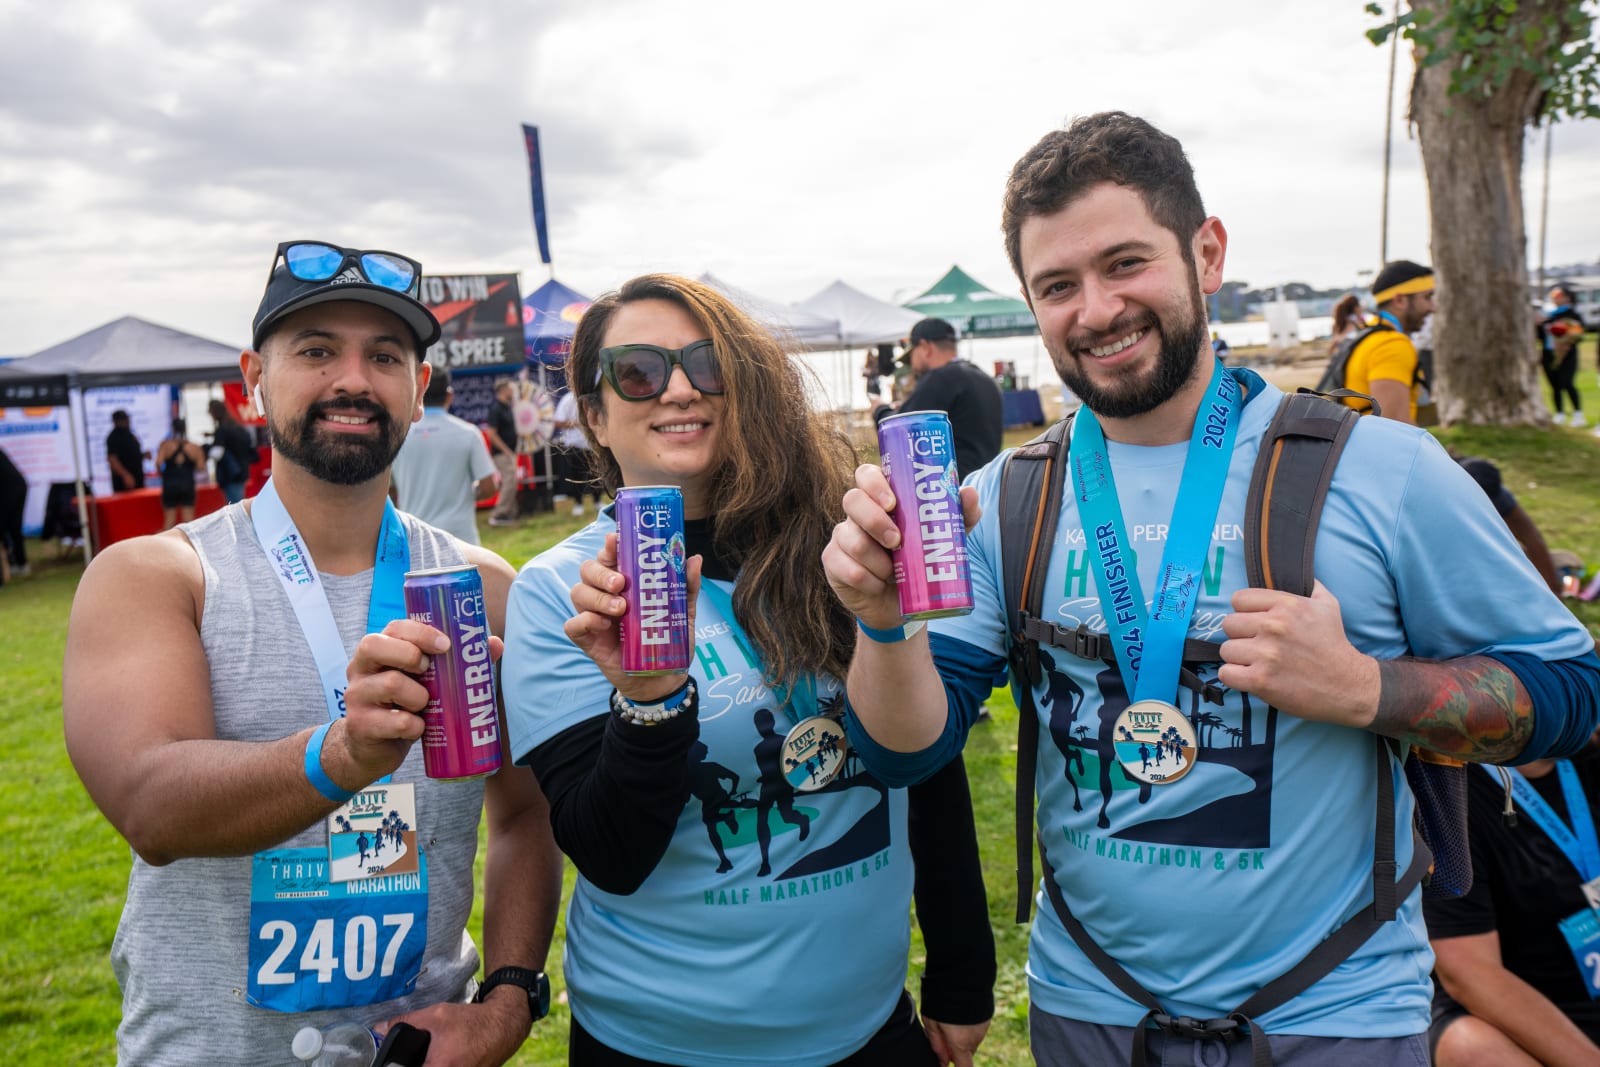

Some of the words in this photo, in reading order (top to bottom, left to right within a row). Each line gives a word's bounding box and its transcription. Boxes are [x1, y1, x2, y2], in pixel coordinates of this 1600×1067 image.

[446, 276, 489, 301] WIN
[449, 336, 506, 366] SPREE
[908, 435, 943, 457] ICE
[1202, 404, 1231, 450] 2024
[635, 510, 668, 529] ICE
[913, 461, 958, 583] ENERGY
[278, 536, 310, 585] THRIVE
[1095, 520, 1137, 625] FINISHER
[454, 595, 482, 617] ICE
[637, 532, 670, 645] ENERGY
[1160, 563, 1186, 621] THRIVE
[459, 623, 498, 748] ENERGY
[349, 792, 387, 807] HRIVE
[367, 865, 385, 874] 2024
[1062, 825, 1090, 851] HALF
[1095, 838, 1201, 868] MARATHON
[1213, 851, 1225, 870] &
[1238, 851, 1265, 870] 5K
[272, 862, 324, 880] THRIV
[346, 875, 421, 895] MARATHON
[704, 888, 750, 905] HALF
[760, 866, 854, 902] MARATHON
[861, 861, 870, 878] &
[875, 850, 890, 871] 5K
[257, 912, 415, 985] 2407
